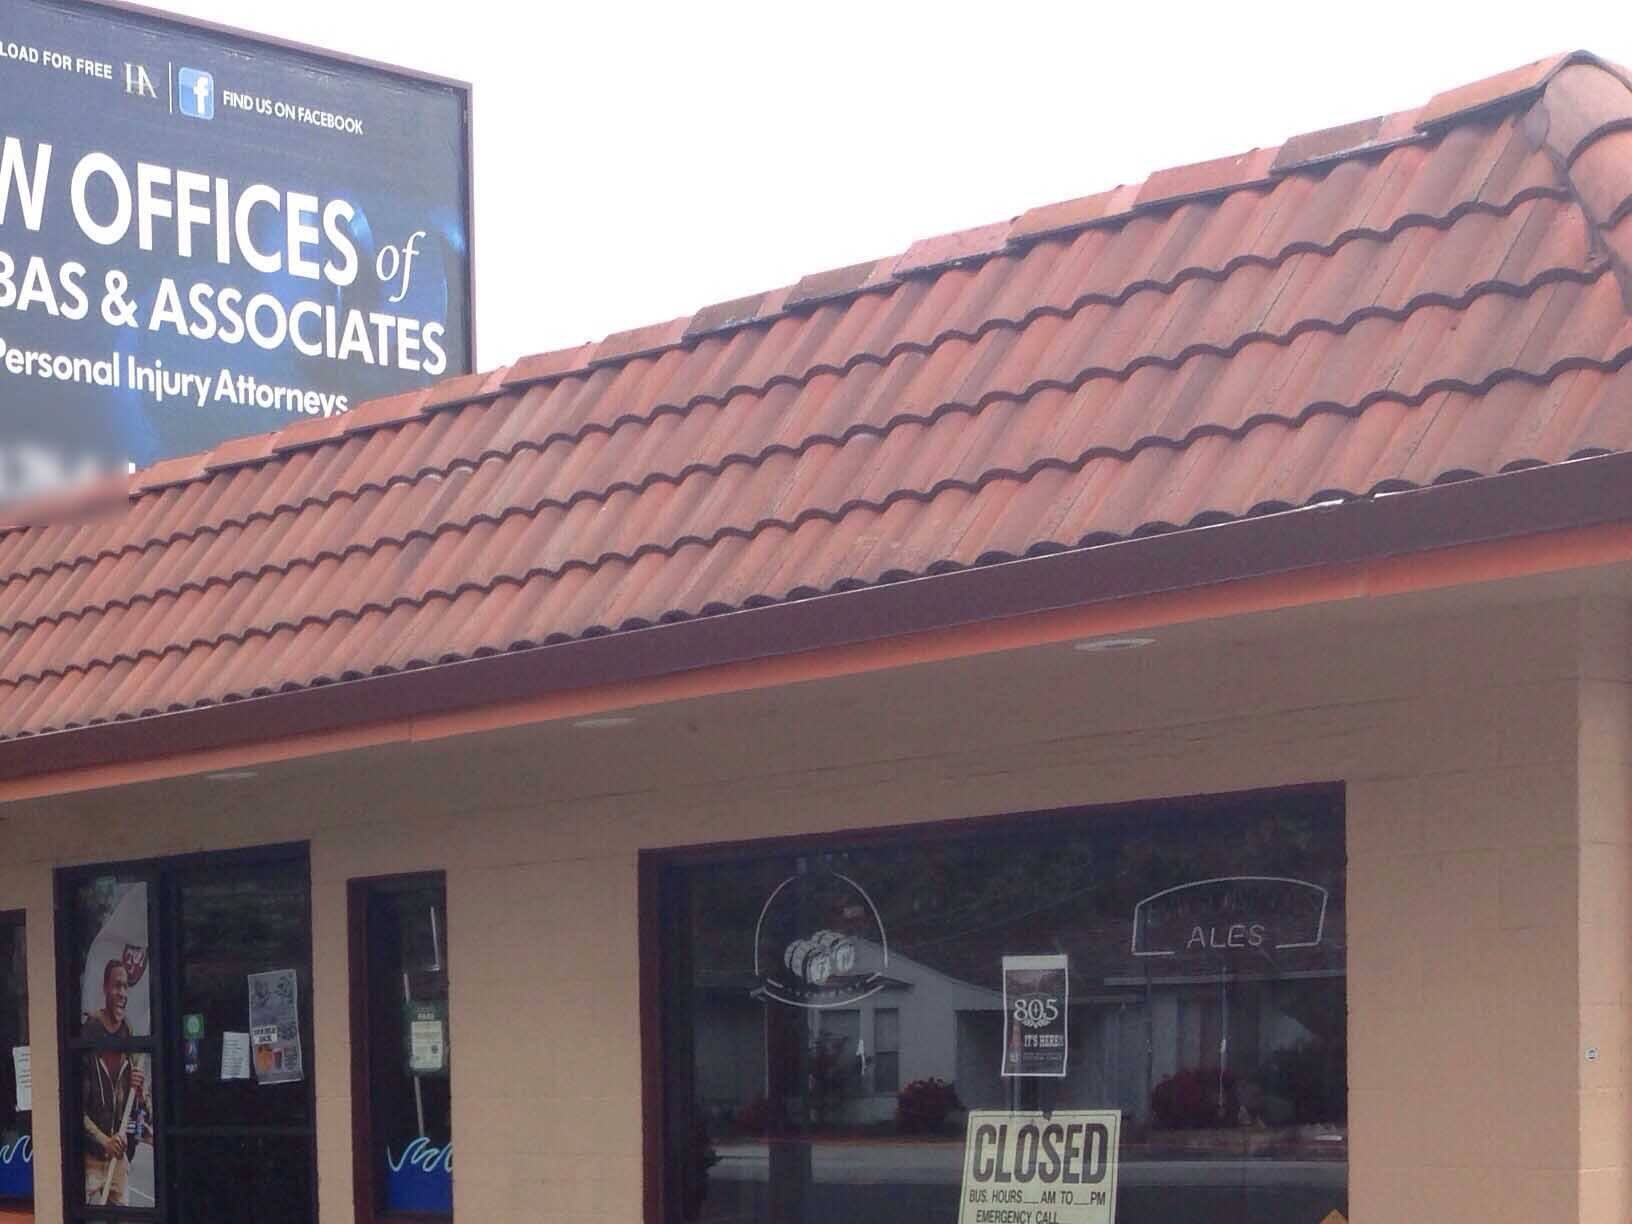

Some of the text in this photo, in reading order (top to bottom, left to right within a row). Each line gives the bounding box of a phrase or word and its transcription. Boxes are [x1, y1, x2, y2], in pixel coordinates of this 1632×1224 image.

[43, 50, 72, 71] FOR
[75, 55, 113, 80] FREE
[223, 90, 364, 135] FIND US ON FACEBOOK
[70, 151, 359, 286] OFFICES
[375, 230, 426, 303] of
[101, 269, 139, 328] &
[149, 277, 448, 376] ASSOCIATES
[128, 355, 212, 403] Injury
[214, 369, 349, 418] Attorneys
[1186, 924, 1265, 949] ALES
[1014, 998, 1058, 1021] 805
[971, 1122, 1109, 1185] CLOSED
[992, 1189, 1023, 1204] HOURS
[1040, 1190, 1057, 1204] AM
[1060, 1191, 1074, 1206] TO
[1089, 1191, 1106, 1206] PM
[976, 1209, 1059, 1224] EMERGENCY CALL
